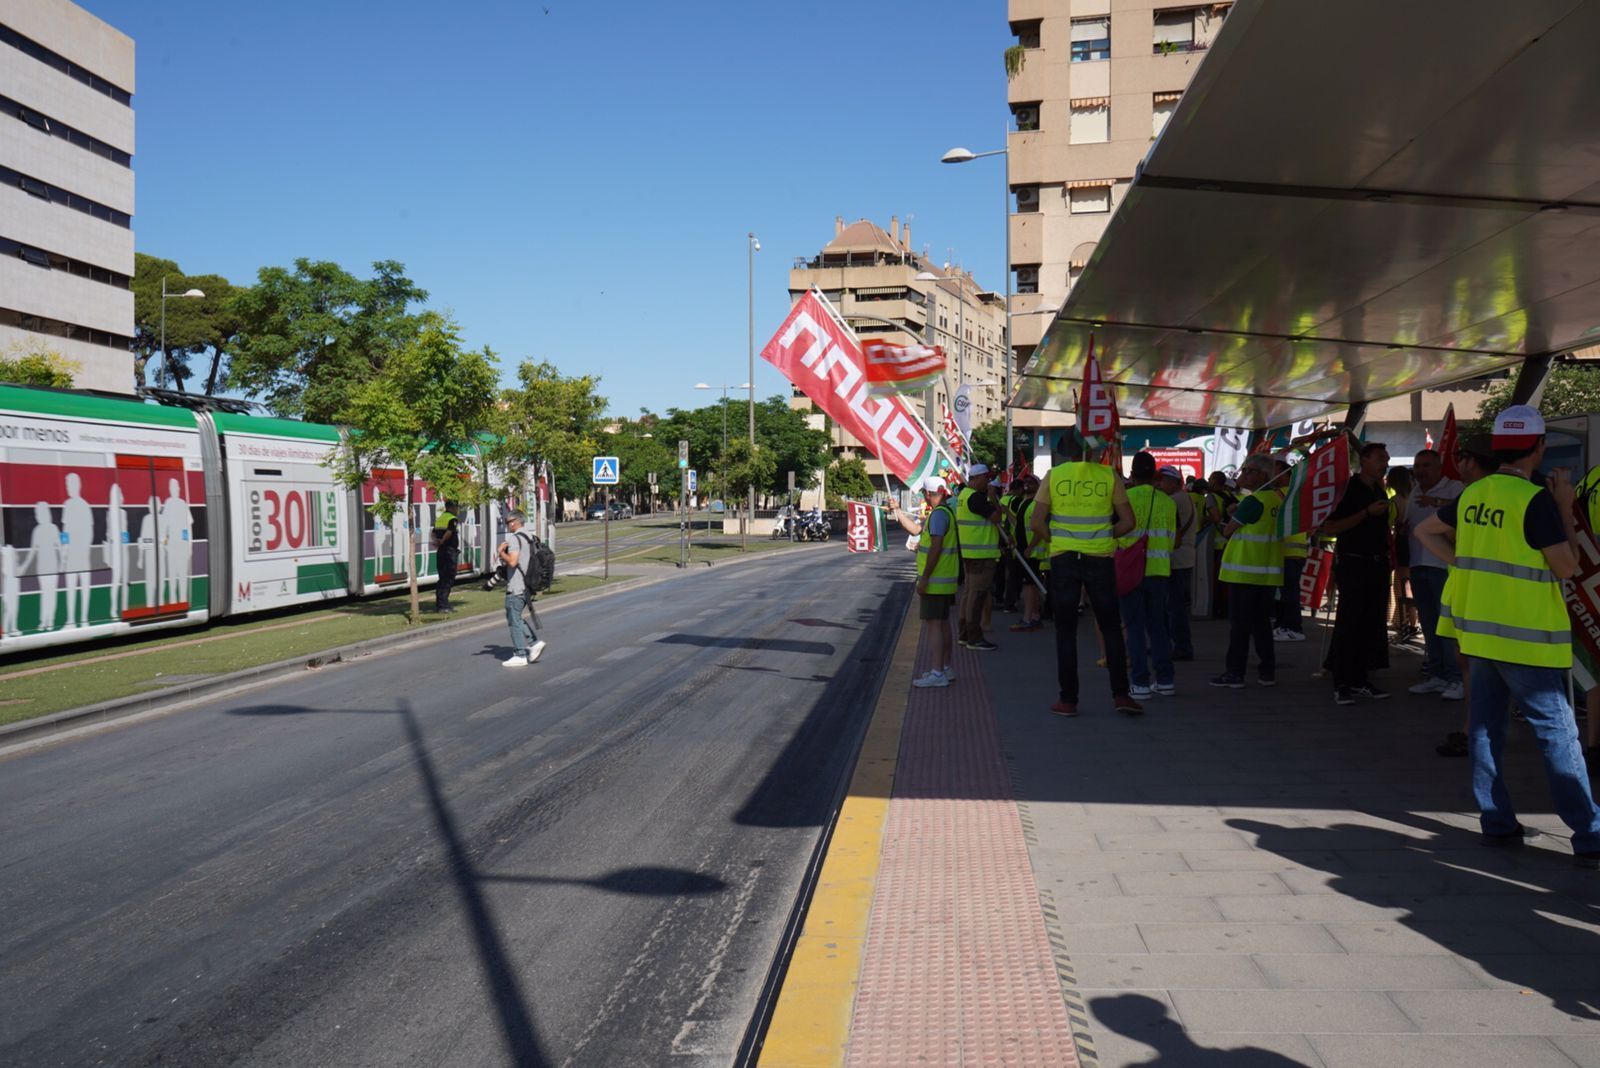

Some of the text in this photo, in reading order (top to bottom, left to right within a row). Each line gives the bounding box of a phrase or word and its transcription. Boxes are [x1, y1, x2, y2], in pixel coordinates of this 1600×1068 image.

[779, 311, 928, 464] CCOO
[23, 427, 70, 443] menos
[248, 490, 337, 552] bono 30 días
[1464, 502, 1504, 528] alsa
